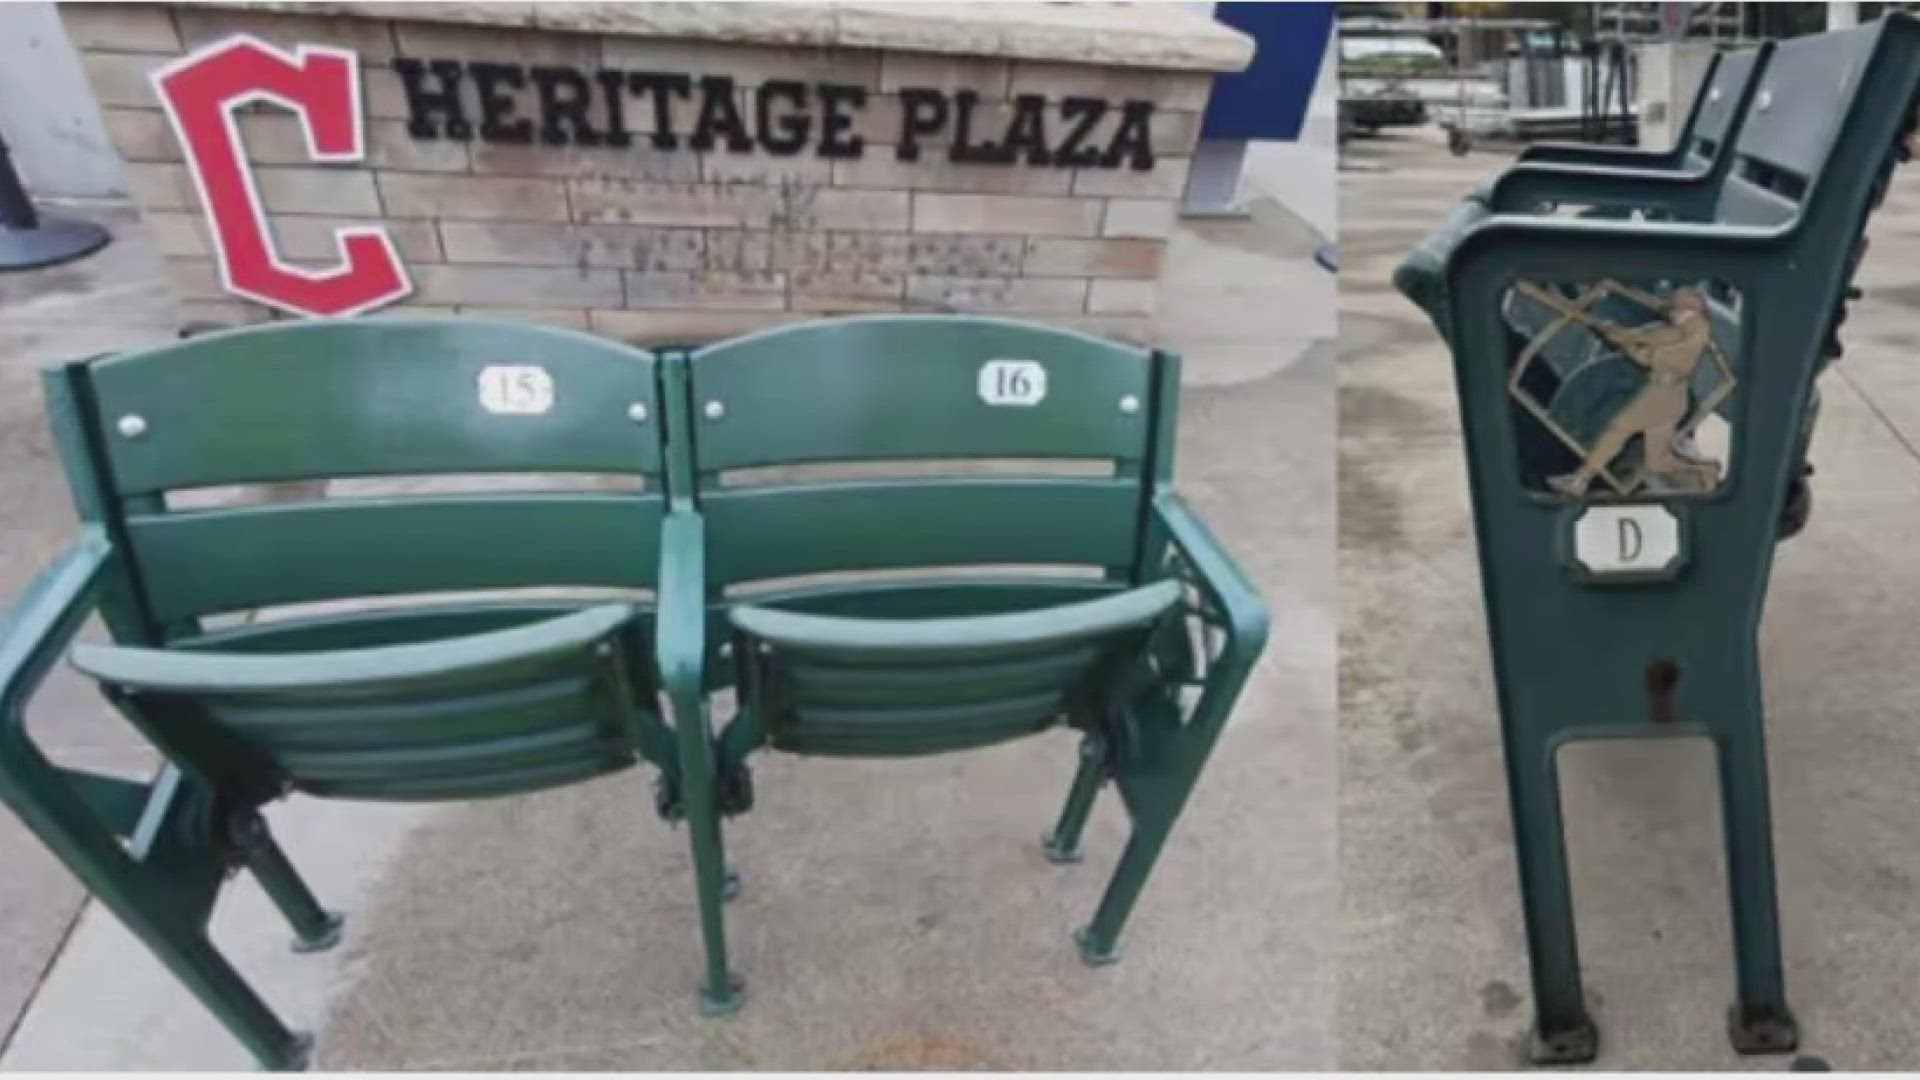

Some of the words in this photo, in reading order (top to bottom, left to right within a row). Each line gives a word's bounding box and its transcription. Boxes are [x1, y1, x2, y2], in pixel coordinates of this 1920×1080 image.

[393, 57, 866, 159] HERITAGE
[895, 88, 1156, 170] PLAZA
[149, 33, 412, 318] C
[500, 372, 537, 407] 15
[996, 365, 1032, 398] 16
[1617, 516, 1642, 562] D
